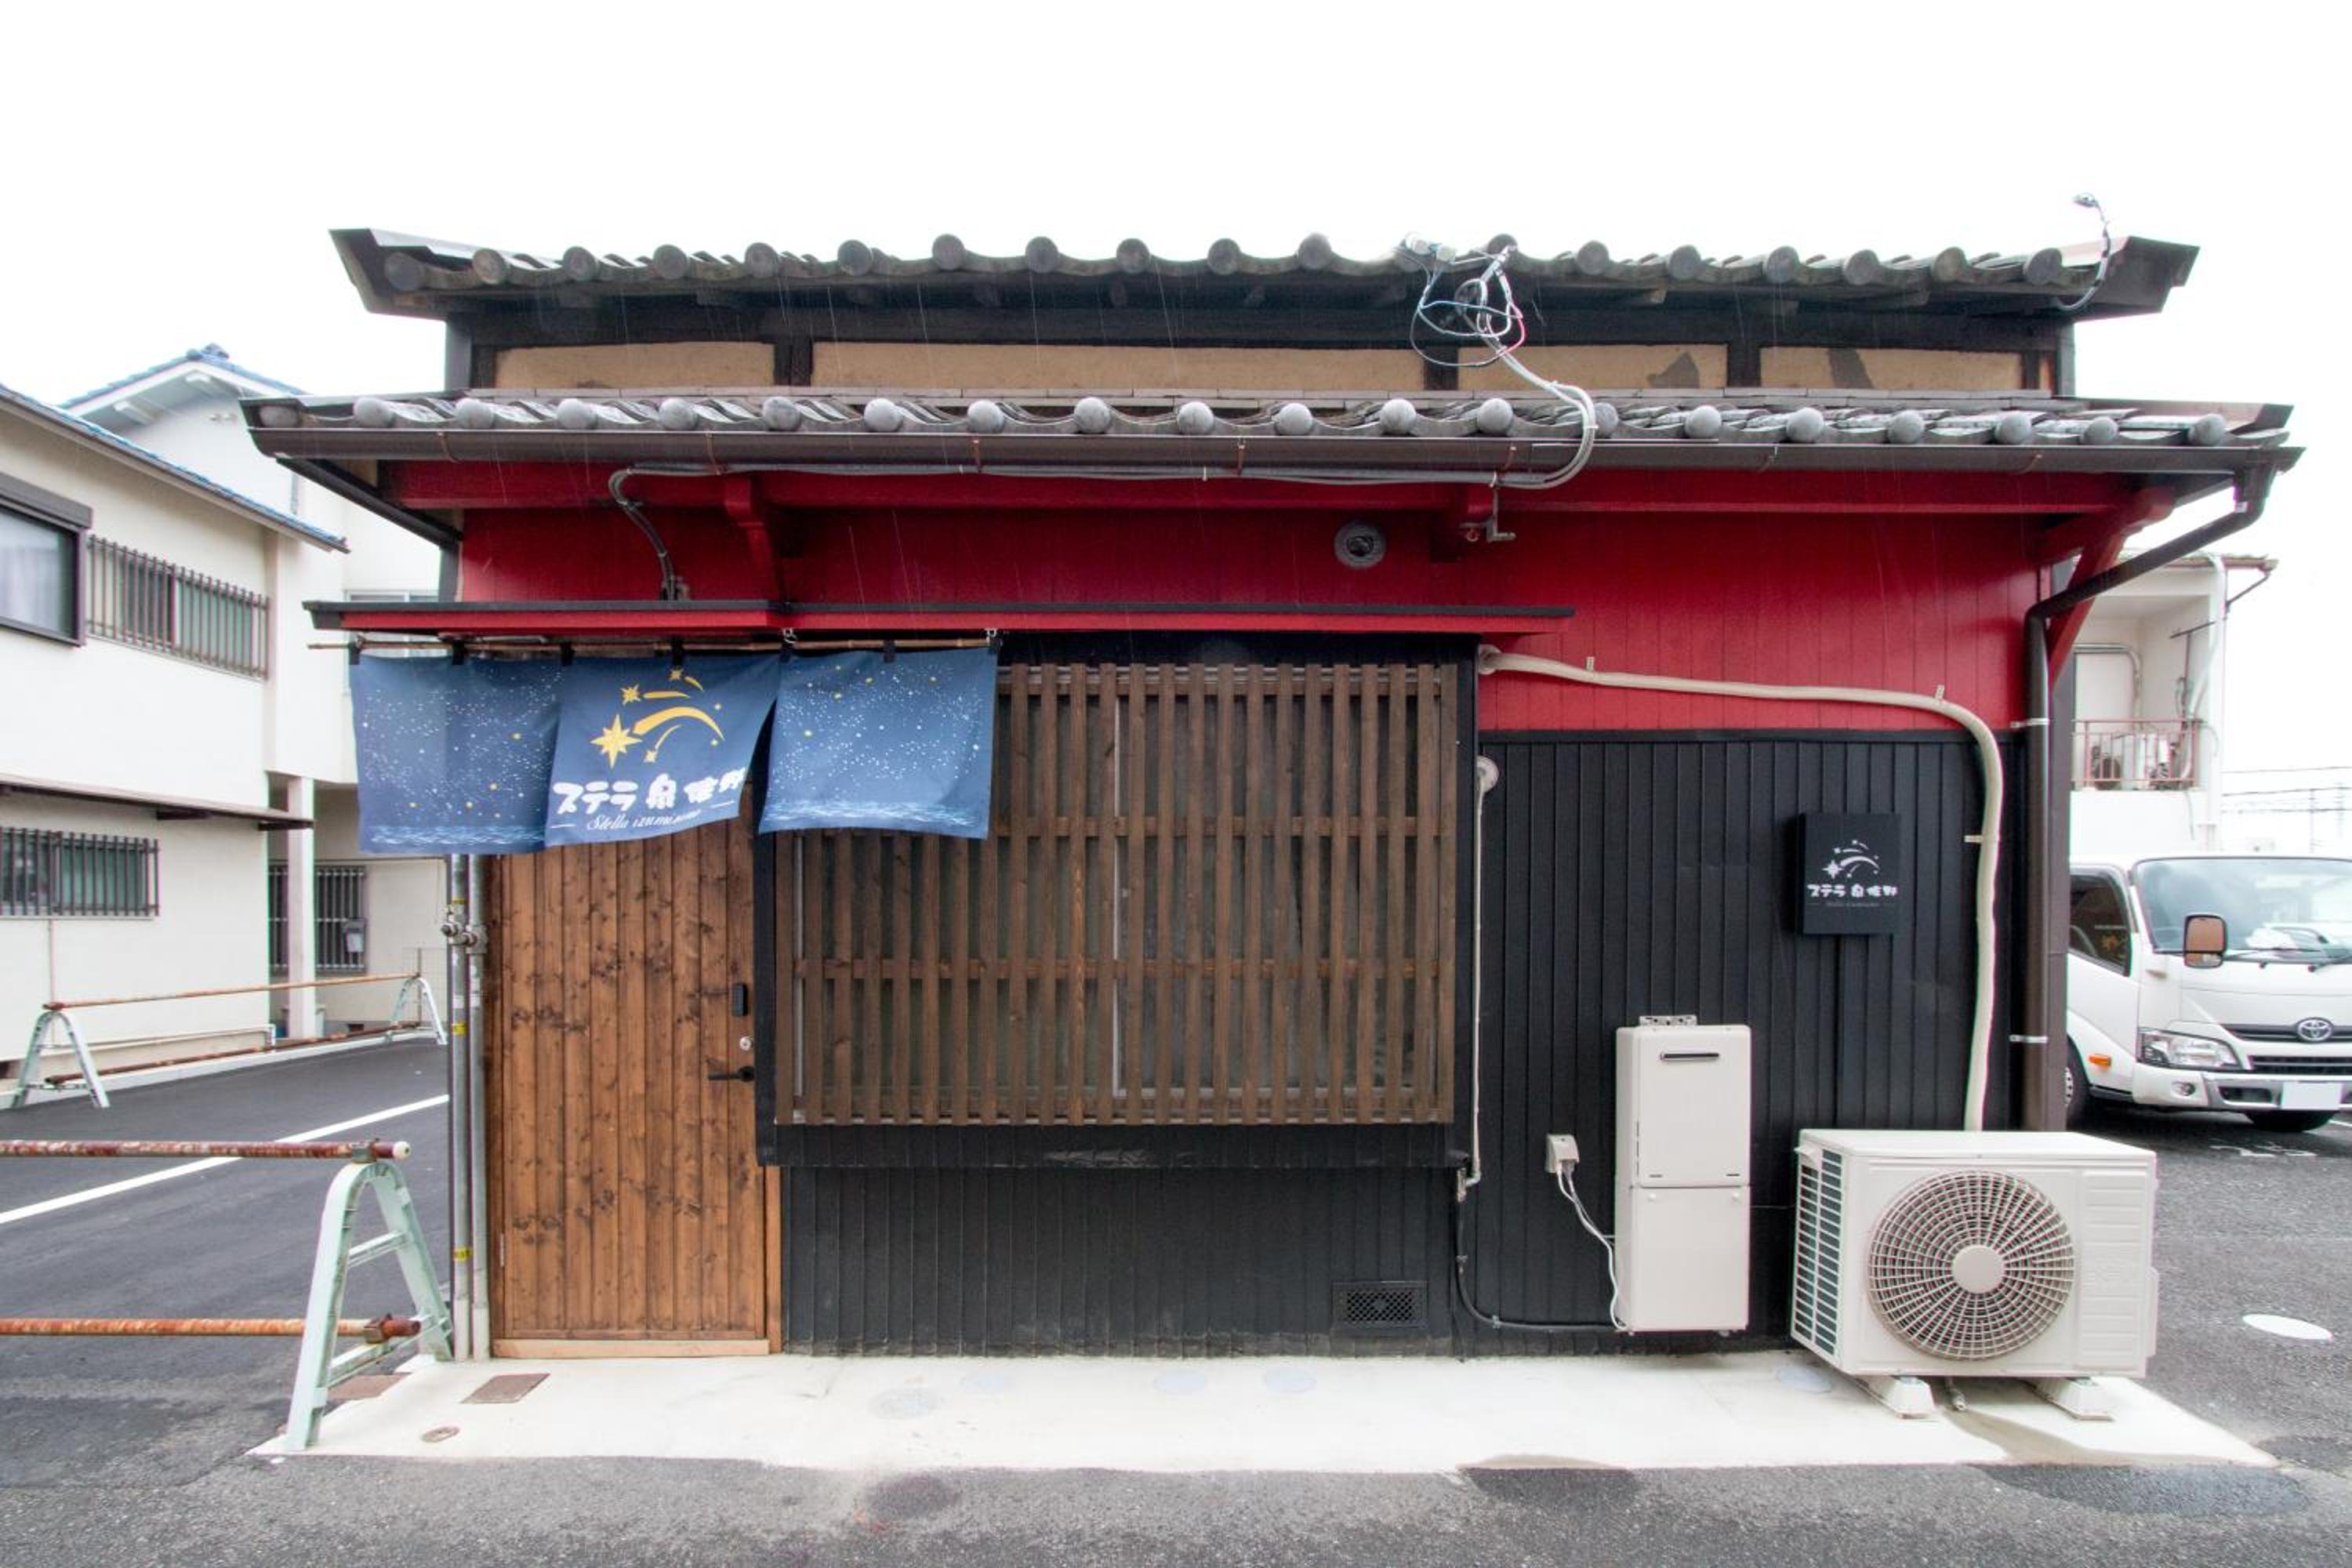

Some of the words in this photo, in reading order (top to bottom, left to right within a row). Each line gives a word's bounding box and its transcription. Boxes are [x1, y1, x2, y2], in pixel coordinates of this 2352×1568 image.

[553, 781, 639, 815] ステラ
[586, 814, 629, 831] Stella
[1806, 884, 1846, 898] ステラ
